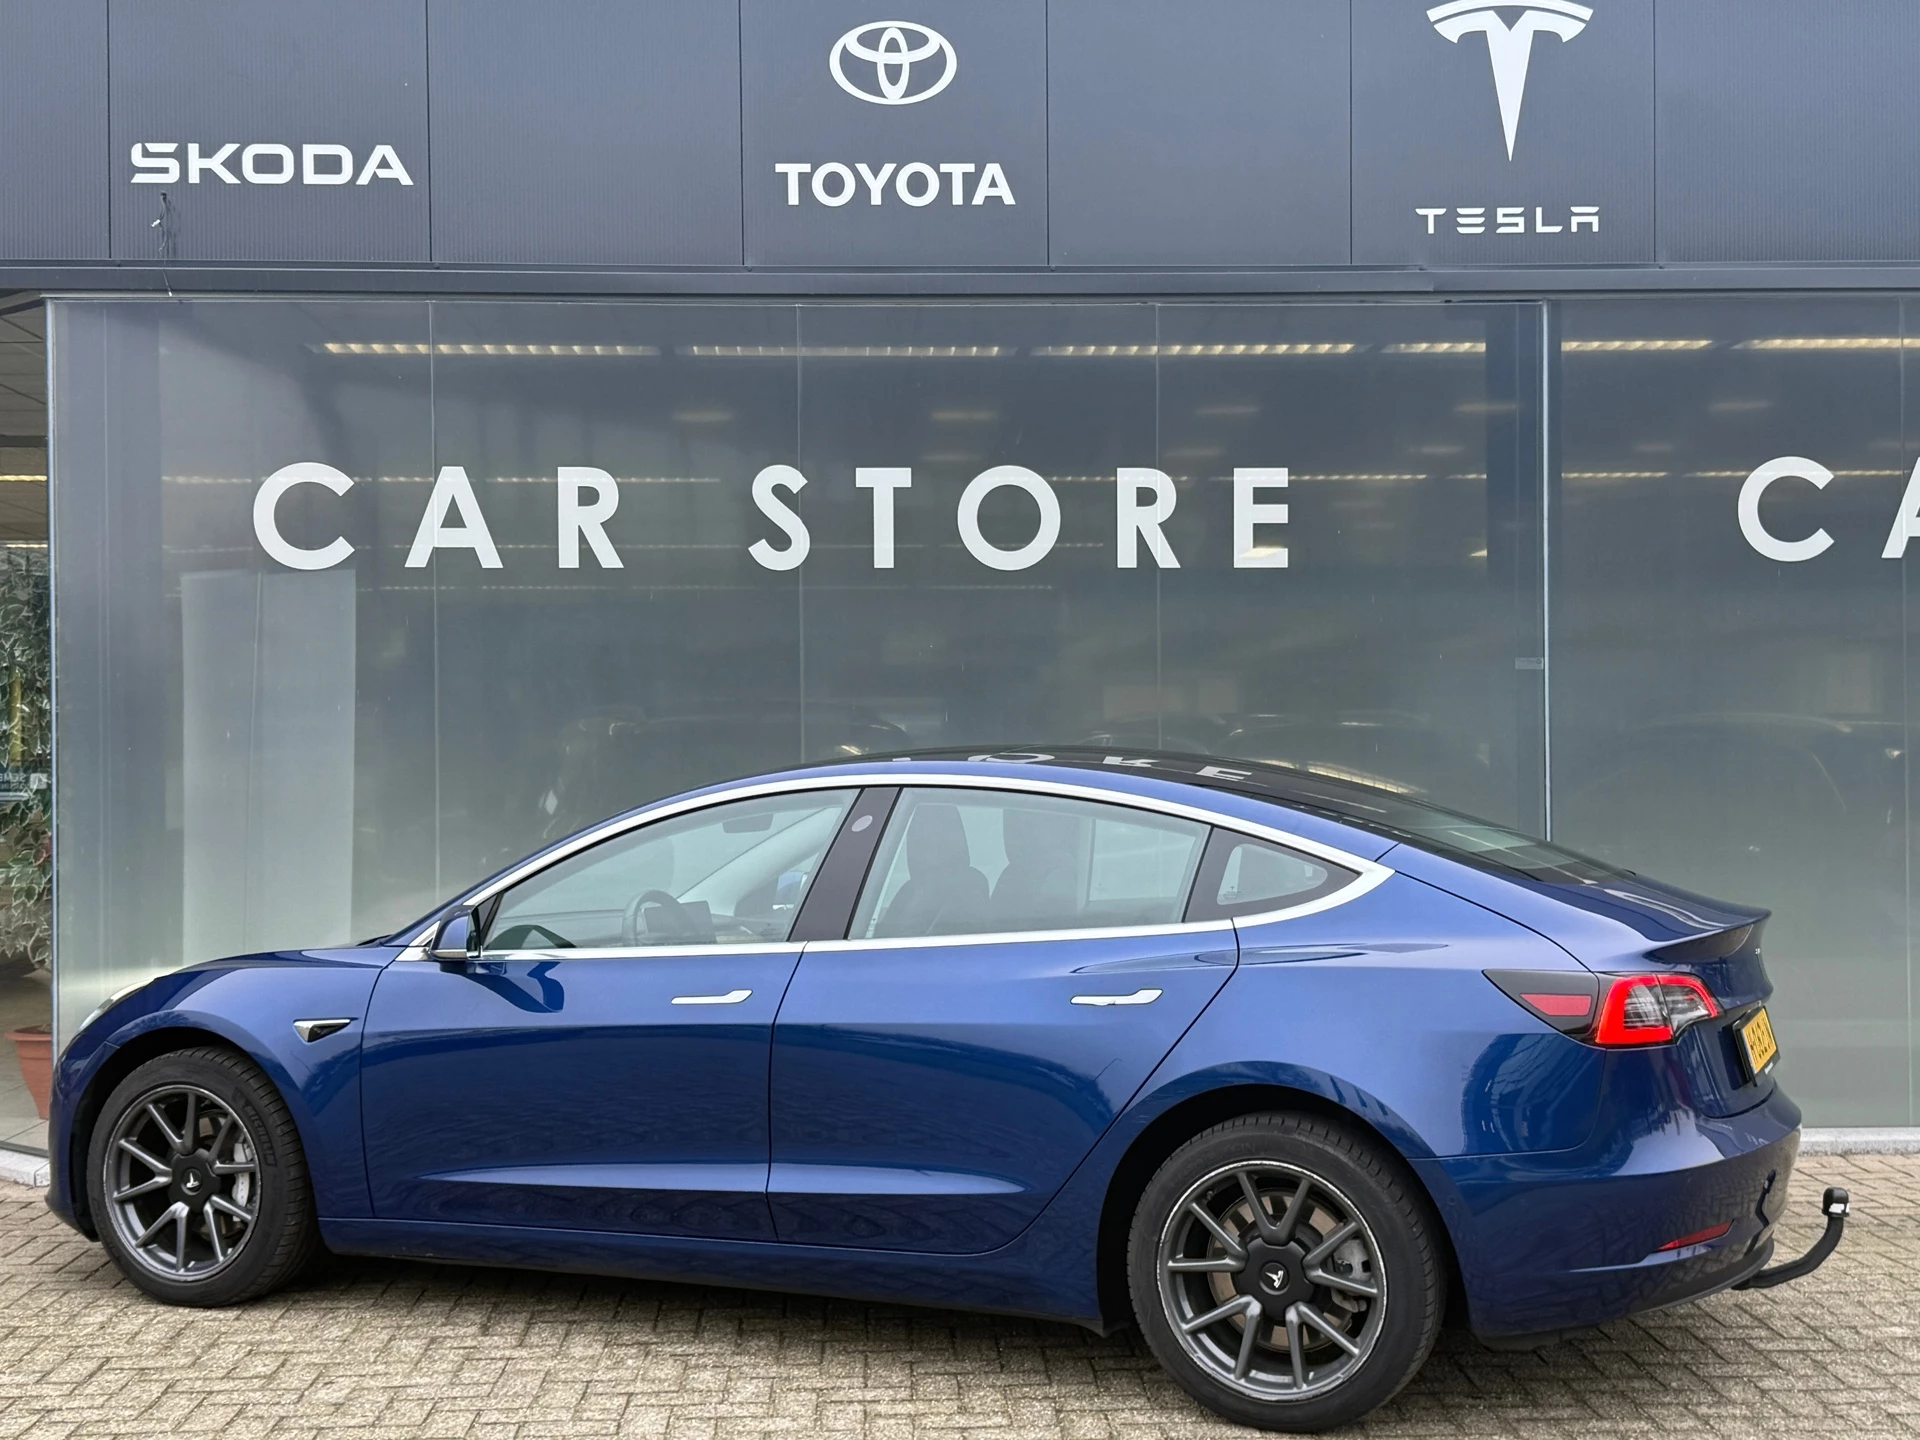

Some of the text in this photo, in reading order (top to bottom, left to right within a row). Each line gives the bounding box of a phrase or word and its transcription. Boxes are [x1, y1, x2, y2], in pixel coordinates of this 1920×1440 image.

[775, 161, 1016, 207] TOYOTA
[1415, 206, 1600, 234] TESLA
[253, 462, 1290, 571] CAR STORE
